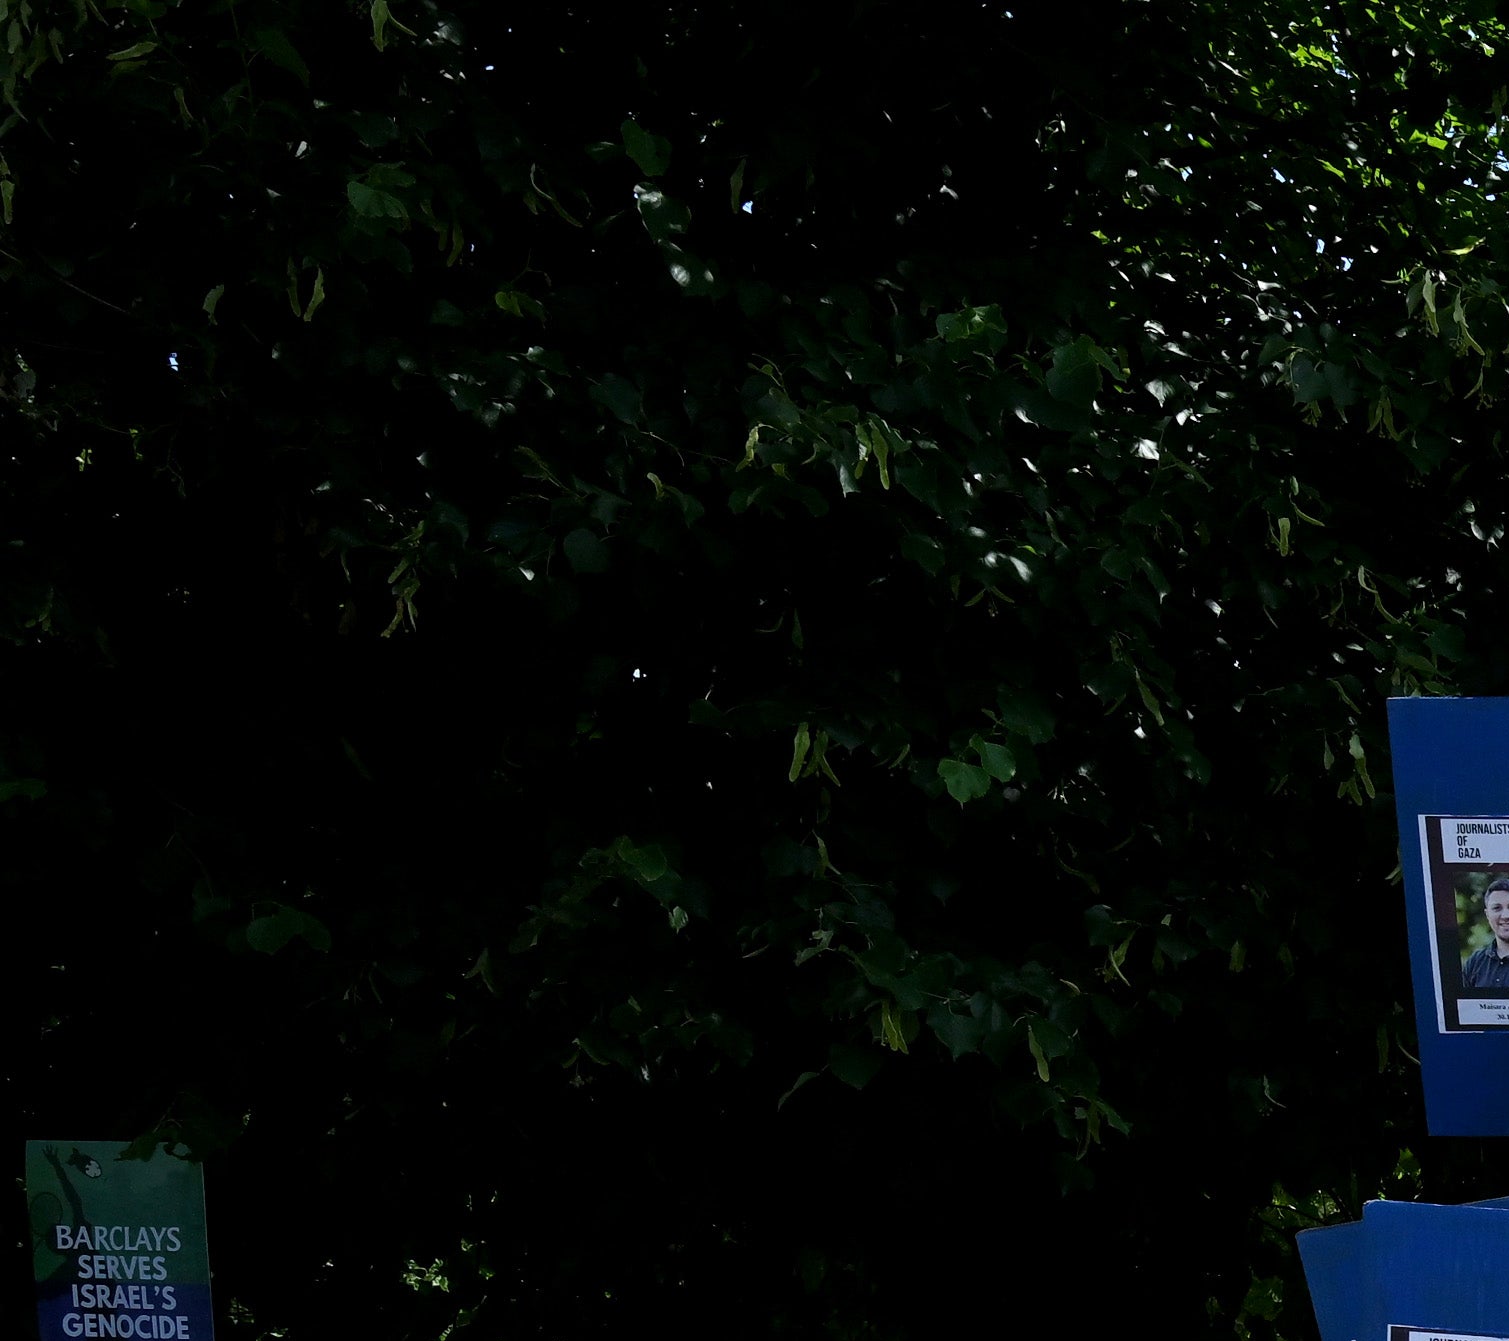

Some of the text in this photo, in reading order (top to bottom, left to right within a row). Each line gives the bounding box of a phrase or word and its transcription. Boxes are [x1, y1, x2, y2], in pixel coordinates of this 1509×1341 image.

[1457, 835, 1468, 847] OF
[1458, 847, 1481, 859] GAZA
[56, 1225, 181, 1251] BARCLAYS
[78, 1255, 168, 1280] SERVES
[72, 1284, 177, 1310] ISRAEL'S
[62, 1313, 190, 1340] GENOCIDE
